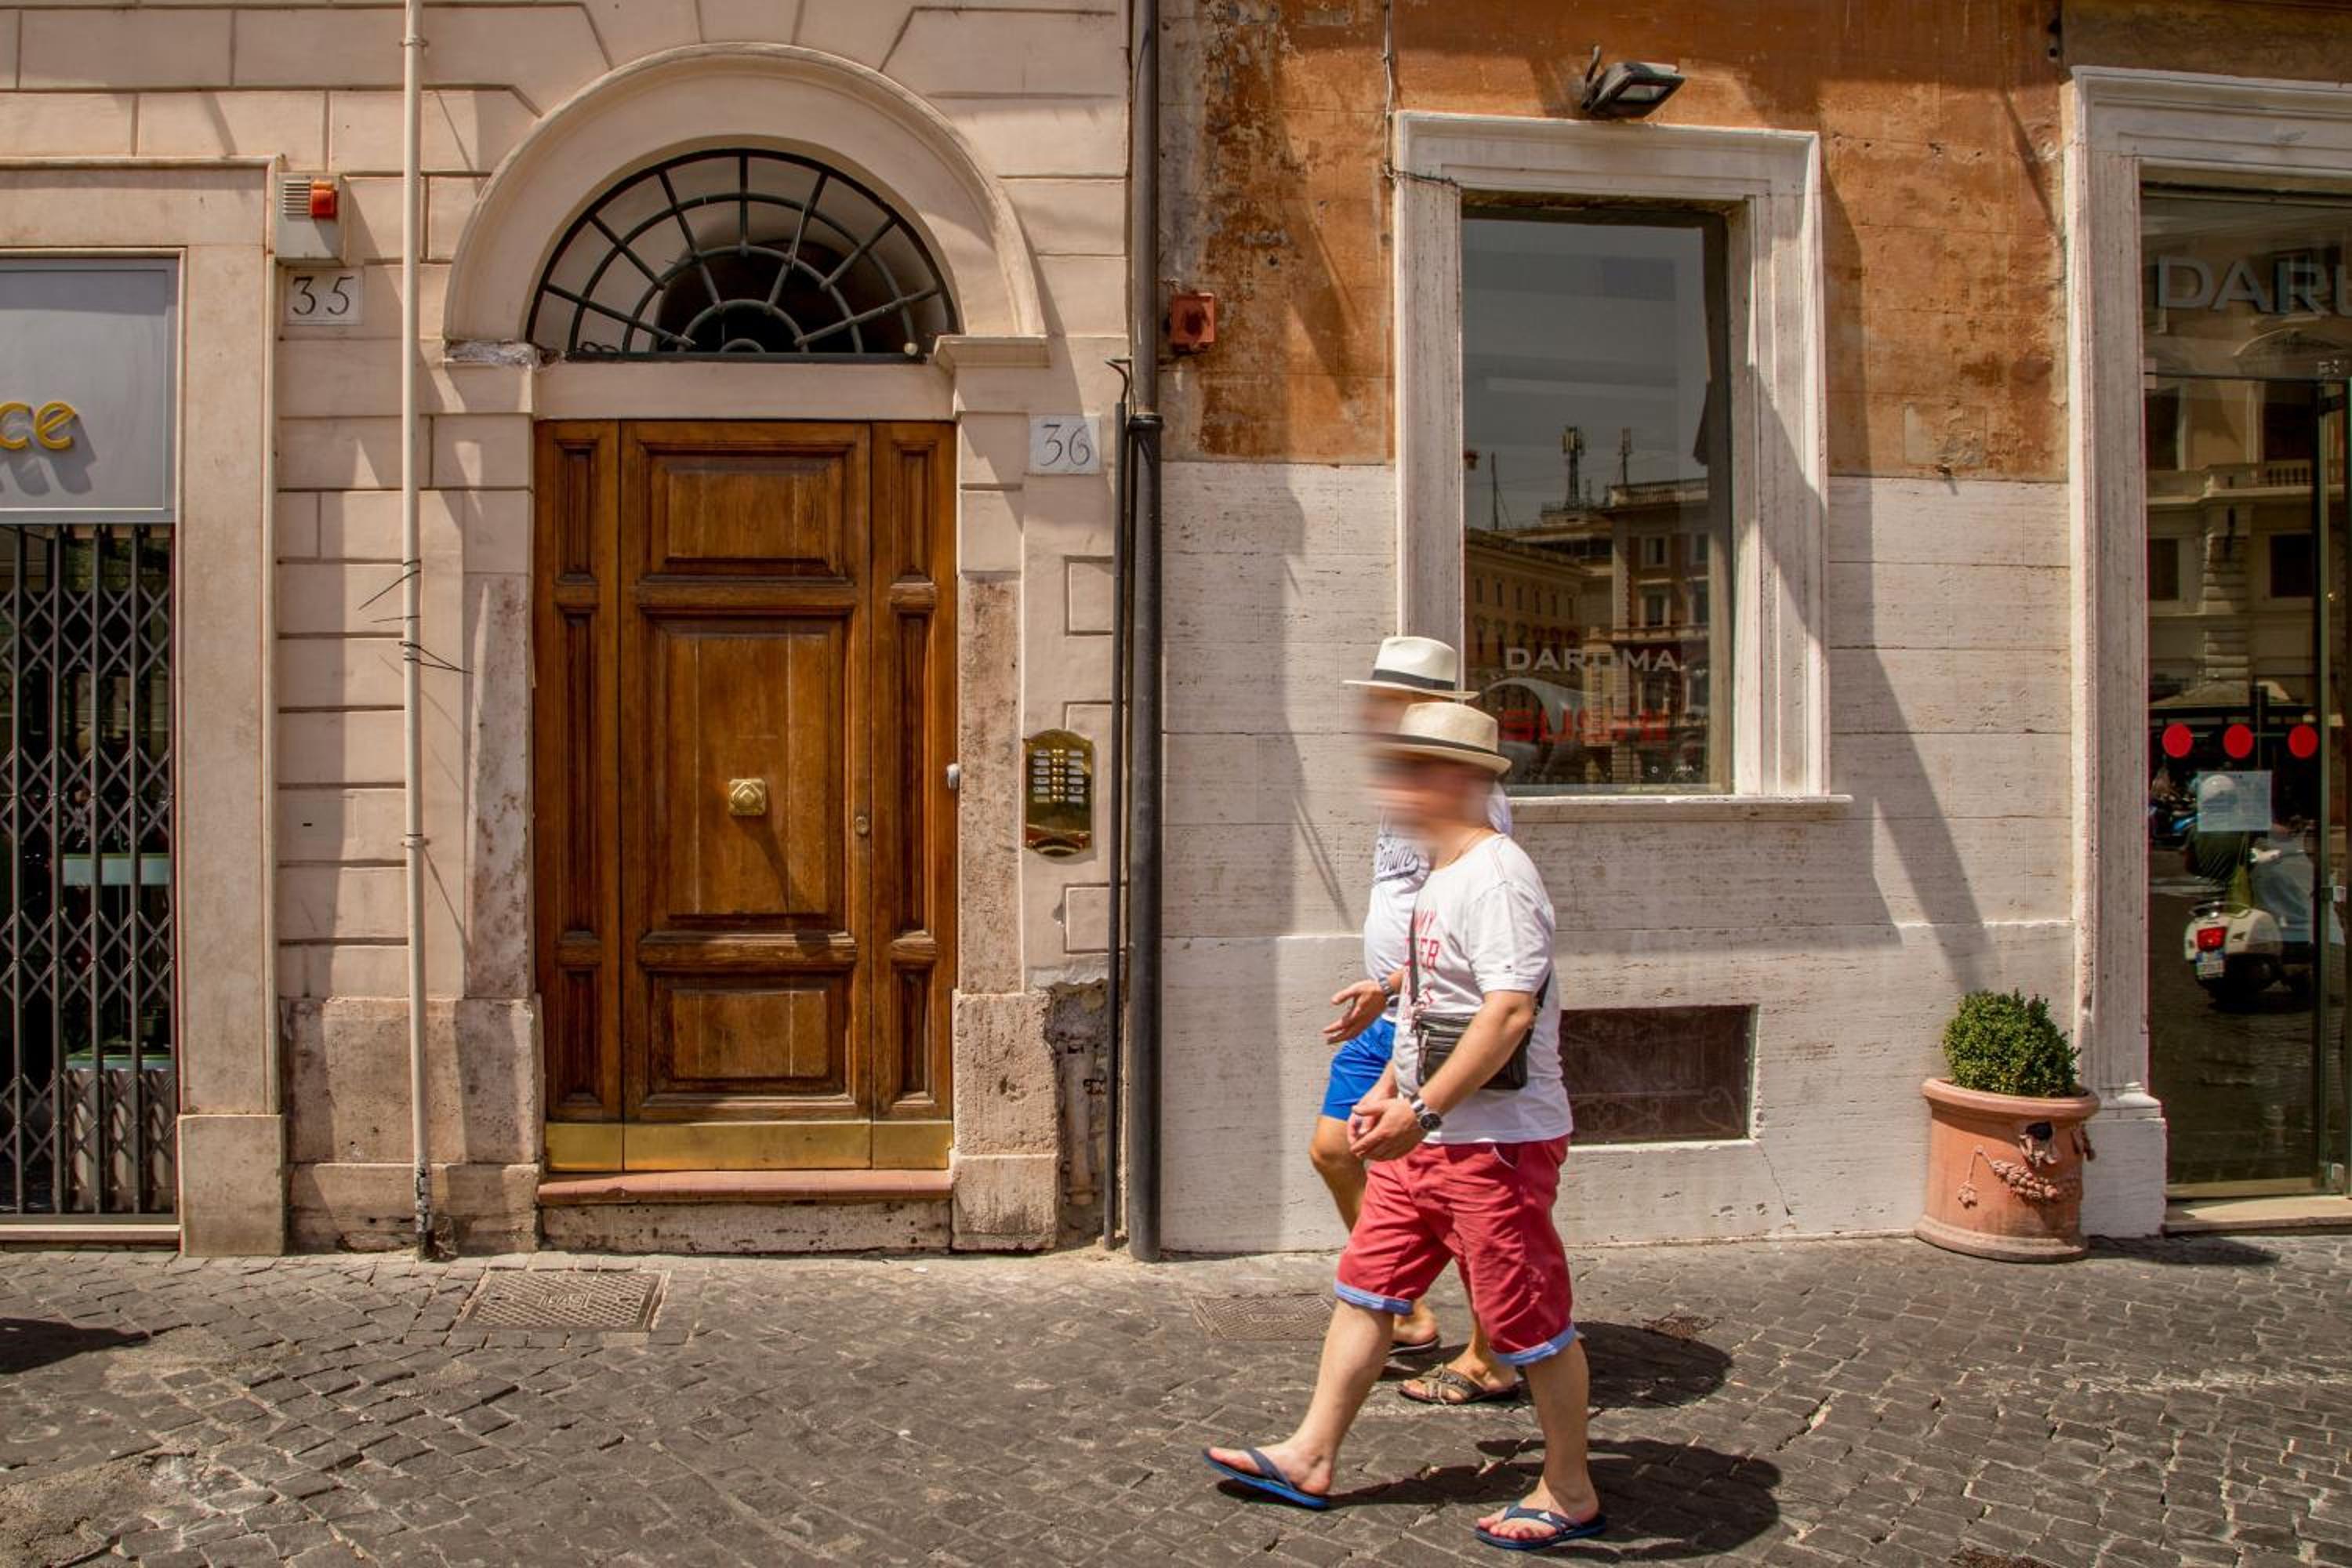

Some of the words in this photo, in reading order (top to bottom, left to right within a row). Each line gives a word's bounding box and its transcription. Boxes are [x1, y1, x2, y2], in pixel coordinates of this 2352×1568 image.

[292, 276, 354, 315] 35
[0, 401, 76, 449] ce
[1041, 424, 1091, 466] 36
